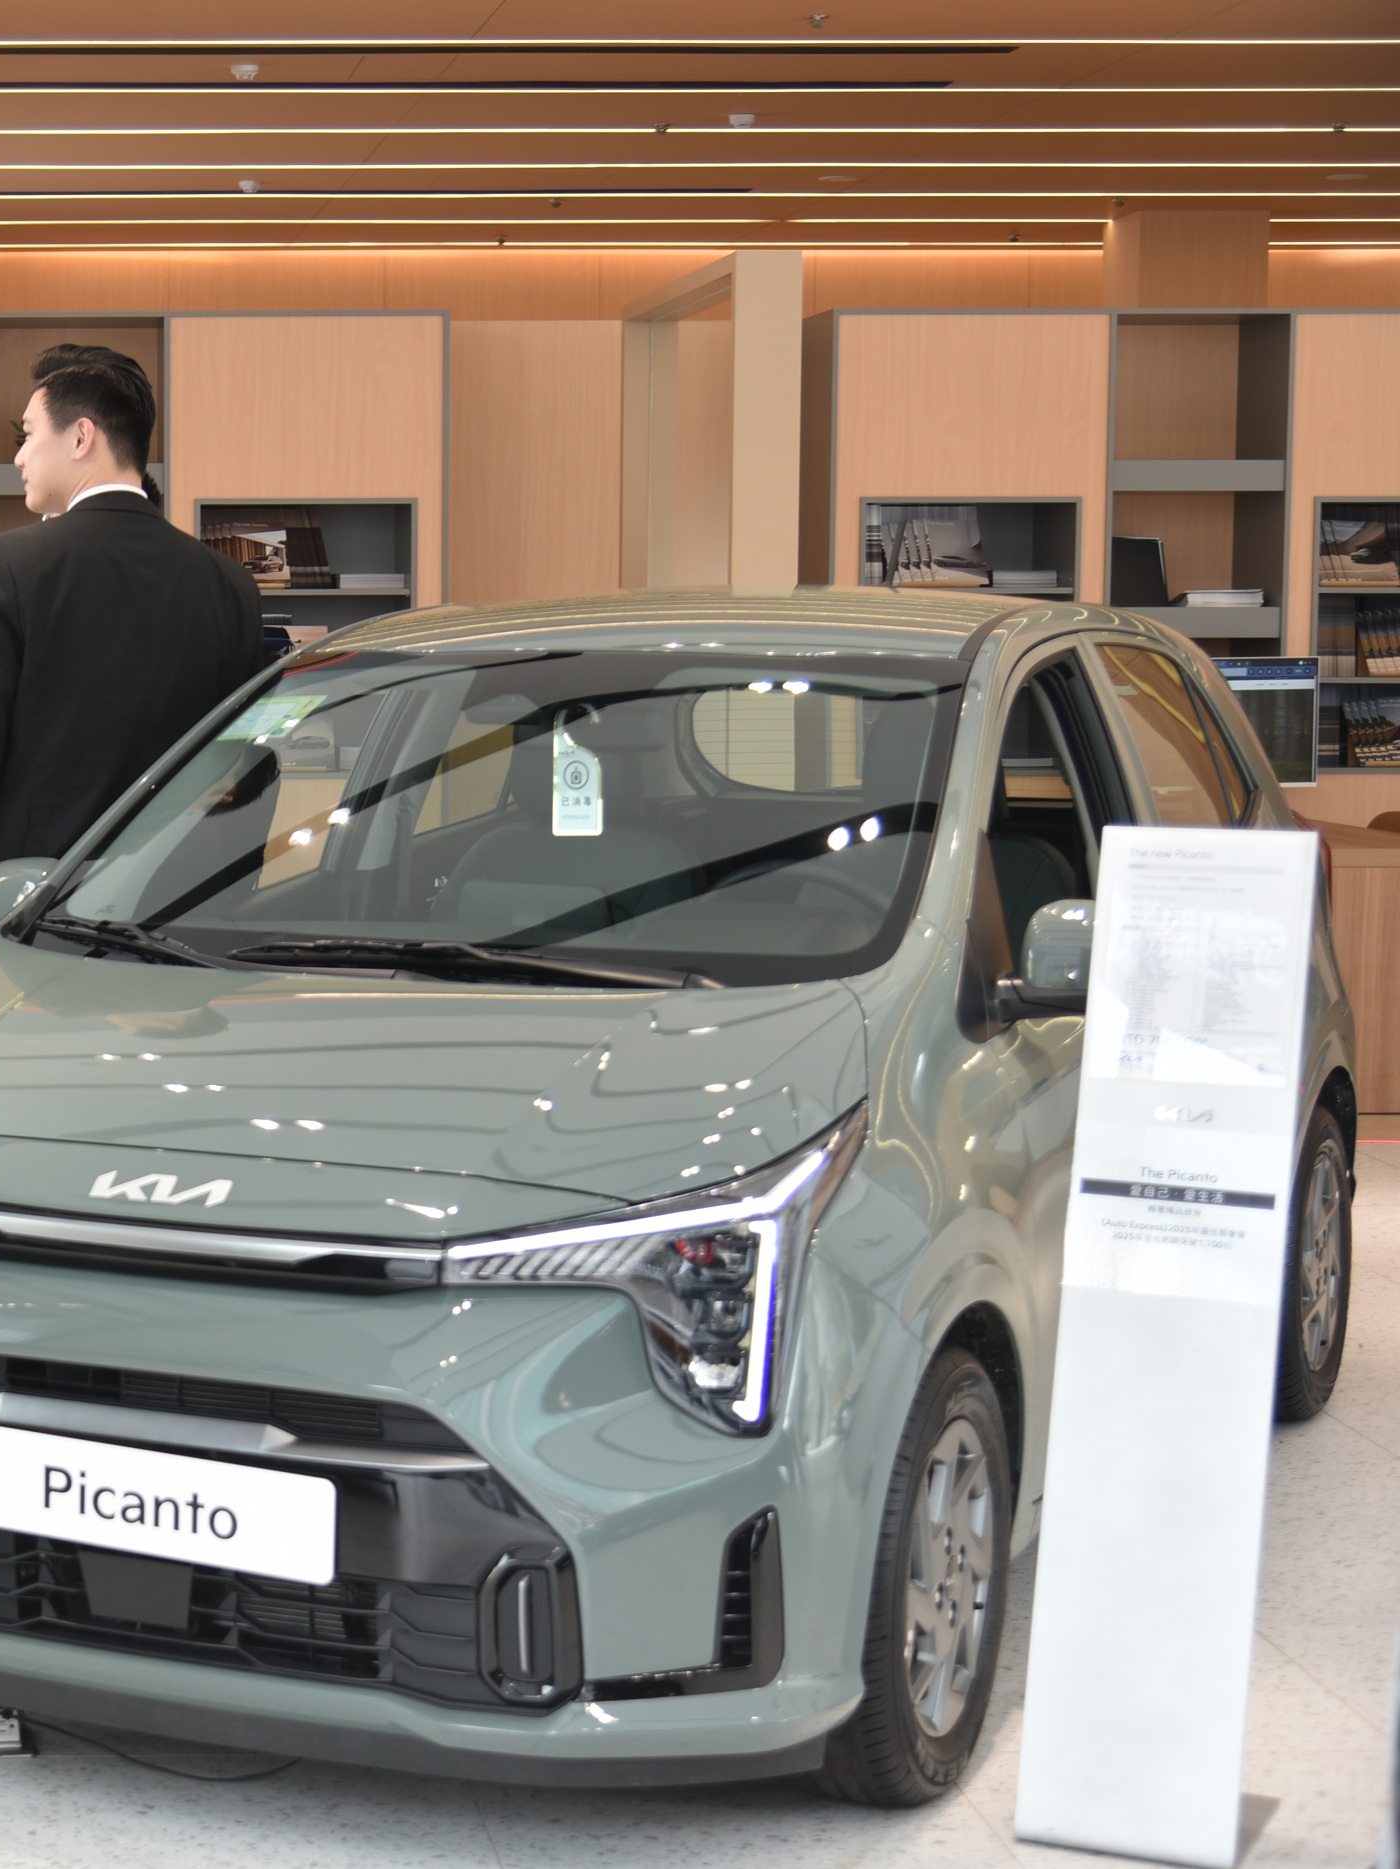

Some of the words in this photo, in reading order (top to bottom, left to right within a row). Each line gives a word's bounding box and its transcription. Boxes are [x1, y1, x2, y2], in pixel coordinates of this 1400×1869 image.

[562, 796, 591, 807] 已消毒
[88, 1170, 234, 1208] KIA
[1139, 1166, 1164, 1179] The
[1168, 1168, 1218, 1184] Picanto
[44, 1465, 238, 1540] Picanto
